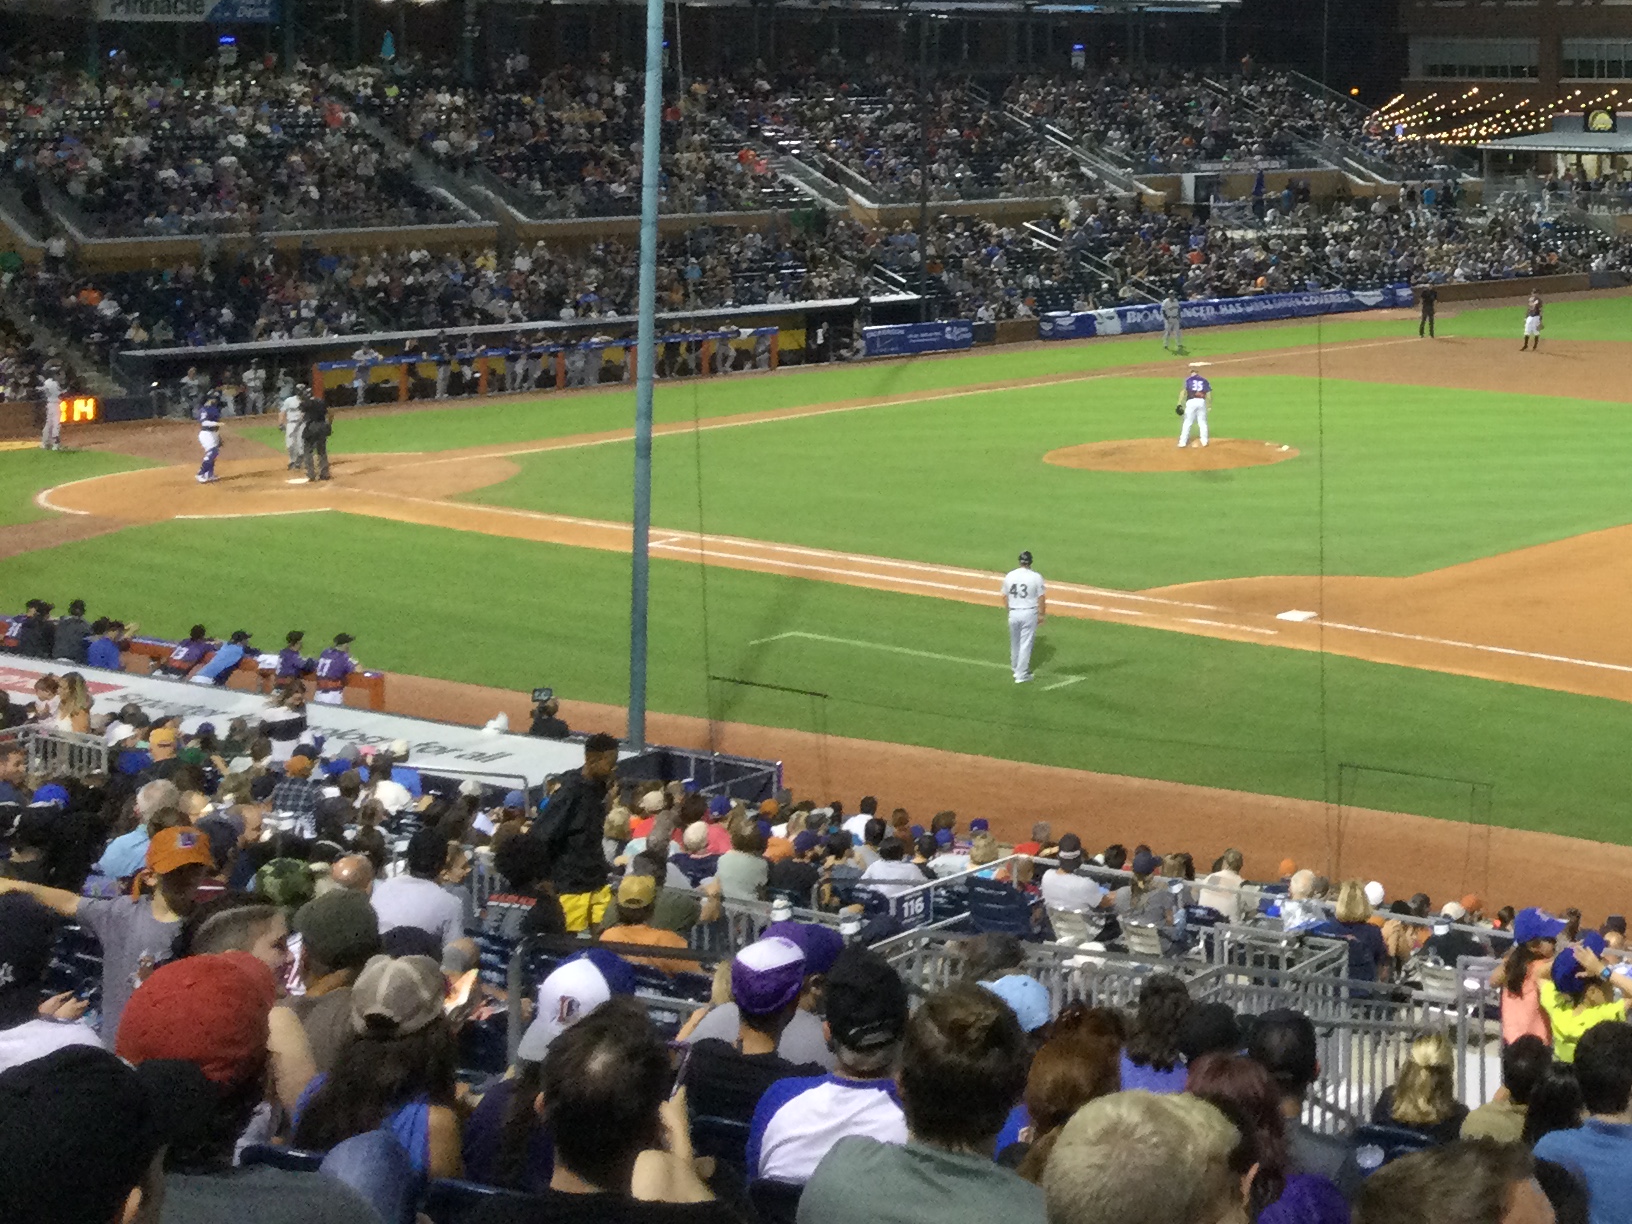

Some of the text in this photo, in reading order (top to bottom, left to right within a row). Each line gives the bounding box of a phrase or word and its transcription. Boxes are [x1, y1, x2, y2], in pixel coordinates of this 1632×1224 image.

[1191, 379, 1204, 392] 35
[1009, 583, 1029, 599] 43
[902, 896, 925, 918] 116
